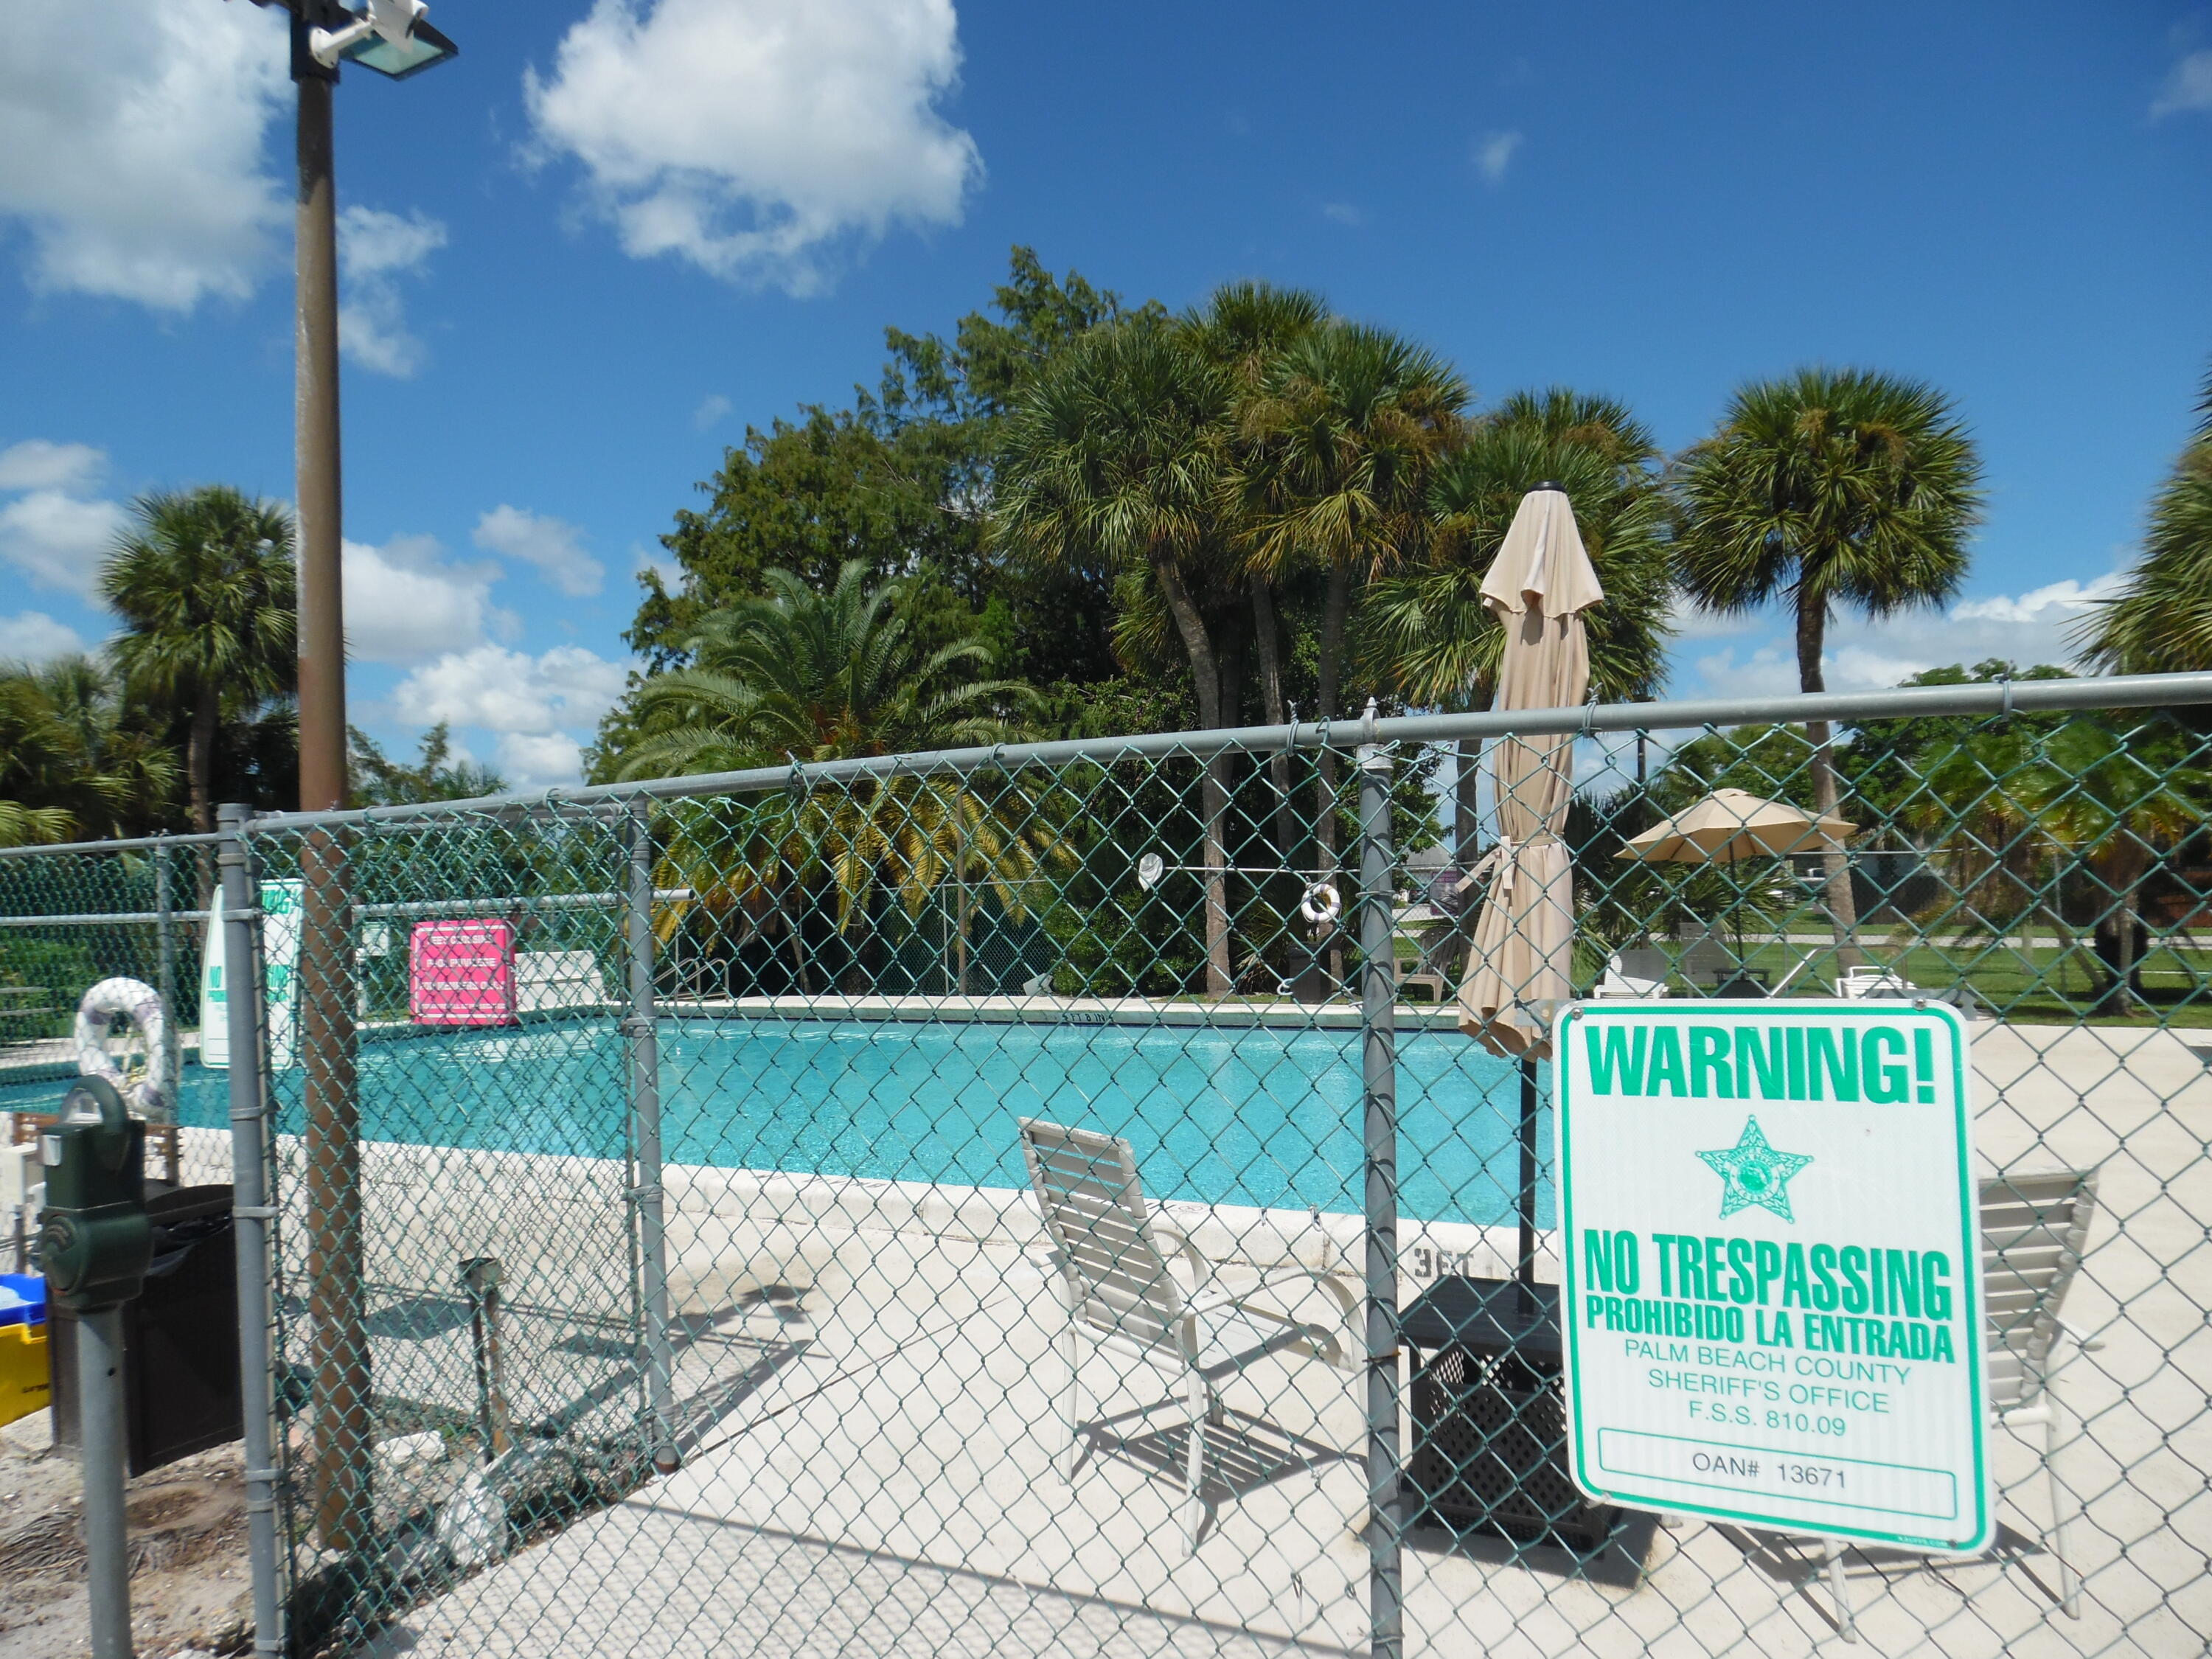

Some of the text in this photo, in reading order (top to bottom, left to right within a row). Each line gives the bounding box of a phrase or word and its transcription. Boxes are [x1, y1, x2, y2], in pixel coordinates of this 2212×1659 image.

[1584, 1025, 1936, 1105] WARNING!
[1584, 1228, 1953, 1323] NO TRESPASSING
[1586, 1295, 1955, 1364] PROHIBIDO LA ENTRADA
[1625, 1339, 1911, 1386] PALM BEACH COUNTY
[1648, 1368, 1890, 1413] SHERIFF'S OFFICE
[1689, 1400, 1846, 1437] F.S.S. 810.09
[1691, 1452, 1846, 1489] OAN# 13671
